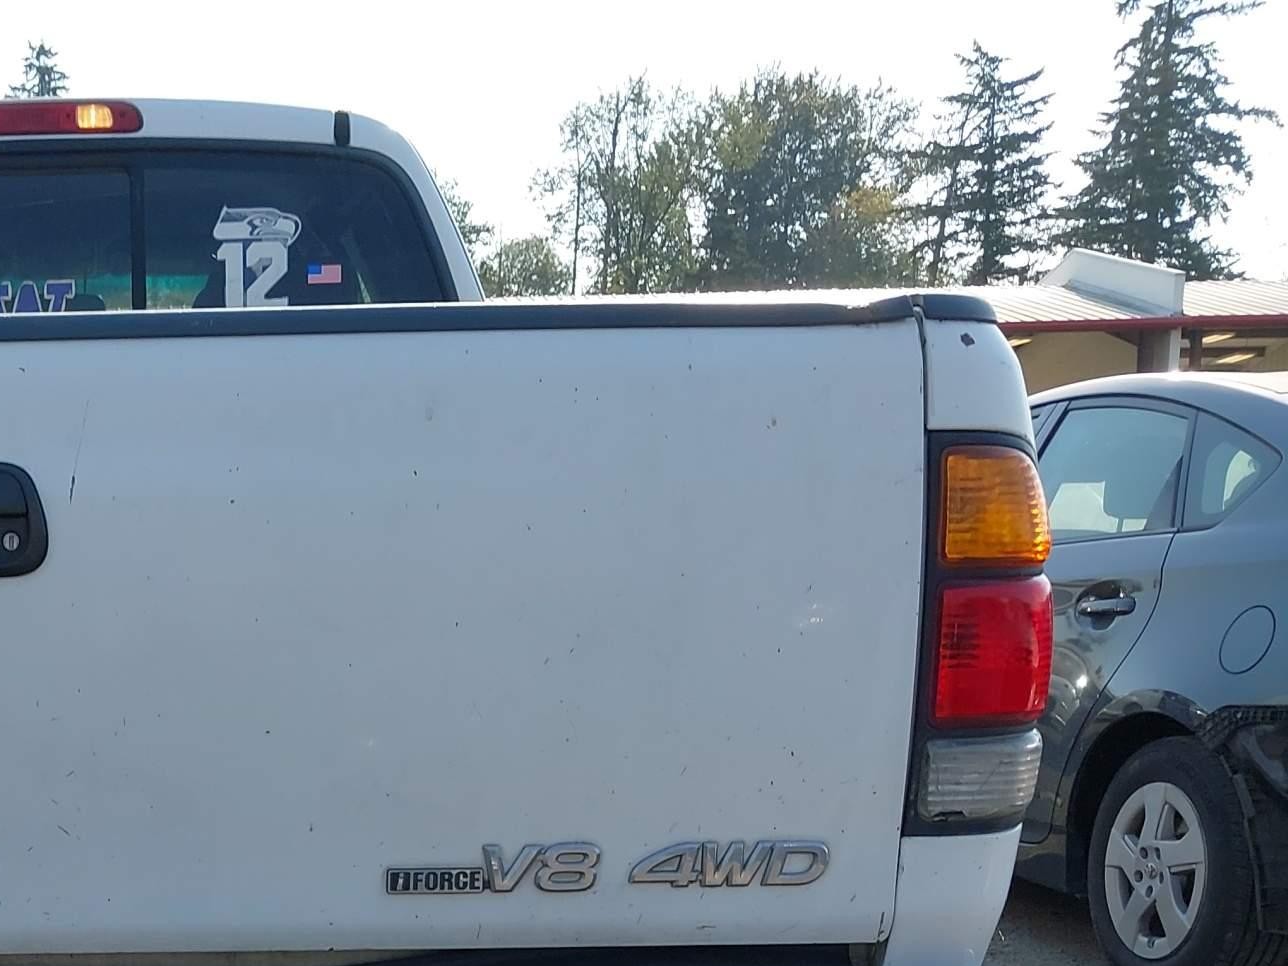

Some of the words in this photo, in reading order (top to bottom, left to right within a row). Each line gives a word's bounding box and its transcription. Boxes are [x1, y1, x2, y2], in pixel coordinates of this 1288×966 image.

[216, 241, 289, 308] 12
[481, 842, 601, 893] V8
[628, 839, 831, 888] 4WD
